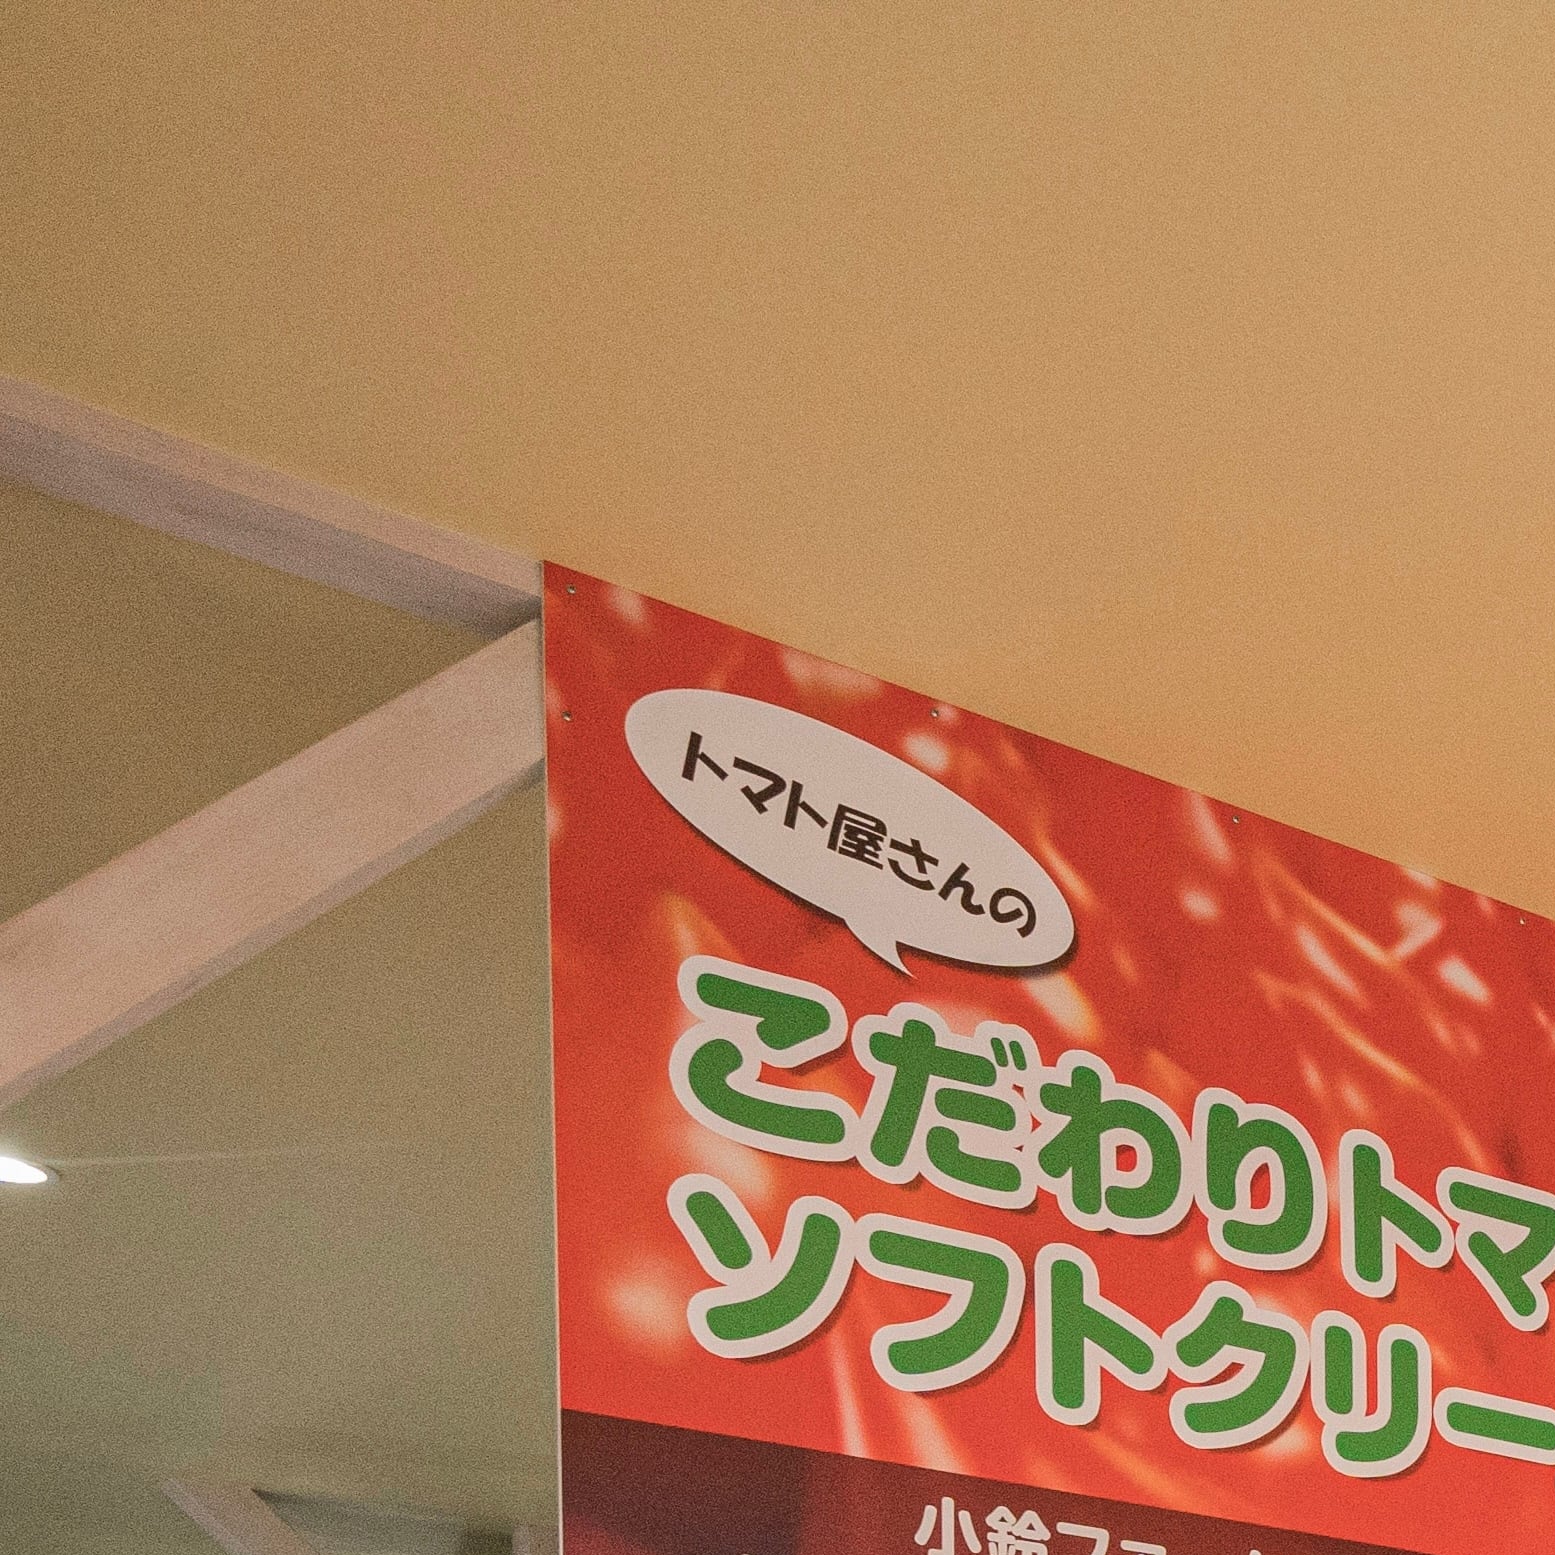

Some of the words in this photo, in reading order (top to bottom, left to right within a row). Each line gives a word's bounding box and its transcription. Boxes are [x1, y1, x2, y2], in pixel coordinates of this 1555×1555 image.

[676, 728, 1039, 942] トマト屋さんの
